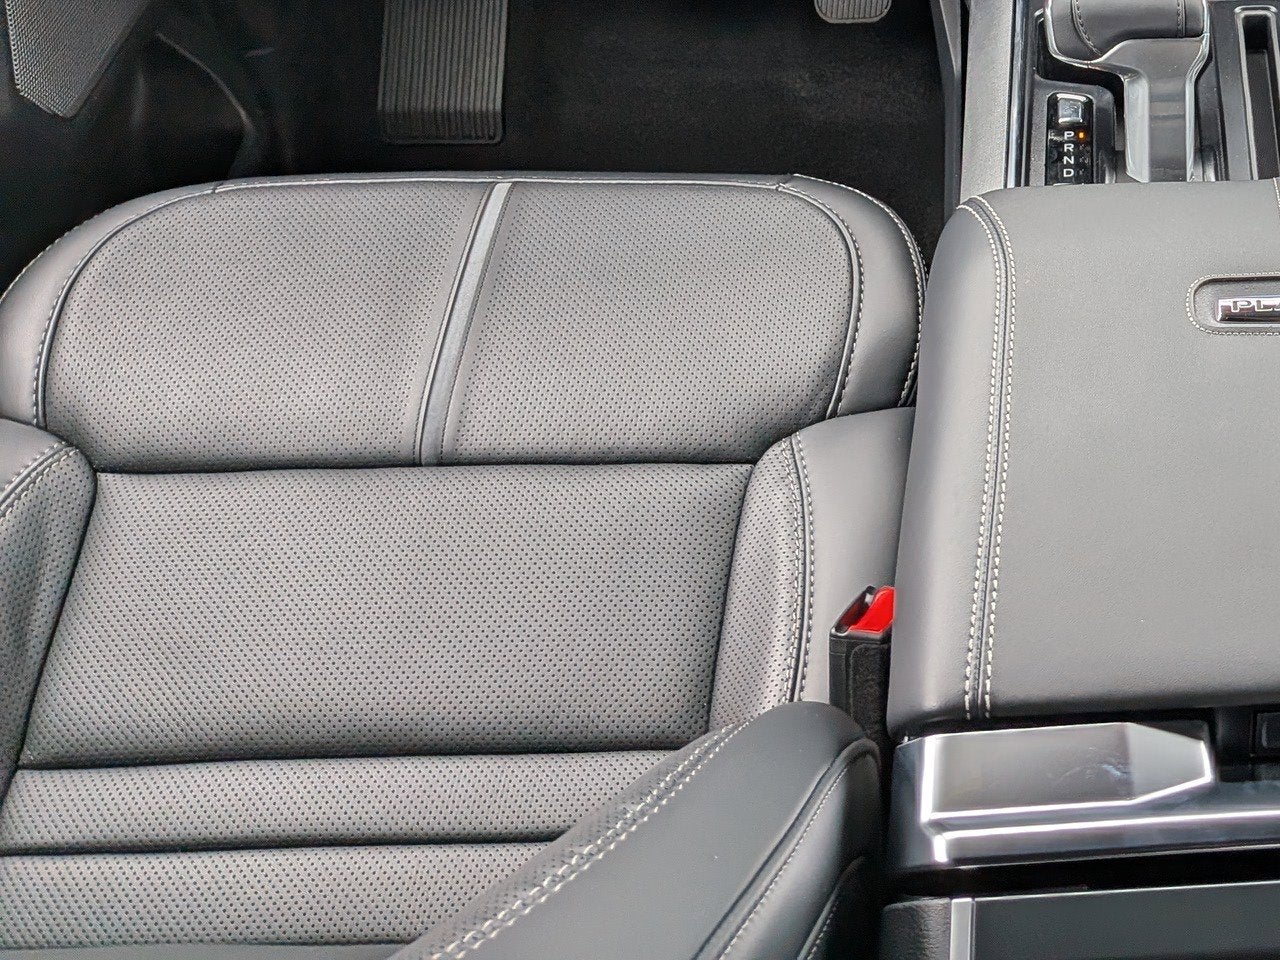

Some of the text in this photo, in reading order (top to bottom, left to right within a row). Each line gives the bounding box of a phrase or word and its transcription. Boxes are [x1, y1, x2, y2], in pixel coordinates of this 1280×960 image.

[1064, 131, 1074, 140] P
[1064, 144, 1074, 152] R
[1064, 156, 1074, 164] N
[1064, 169, 1074, 178] D
